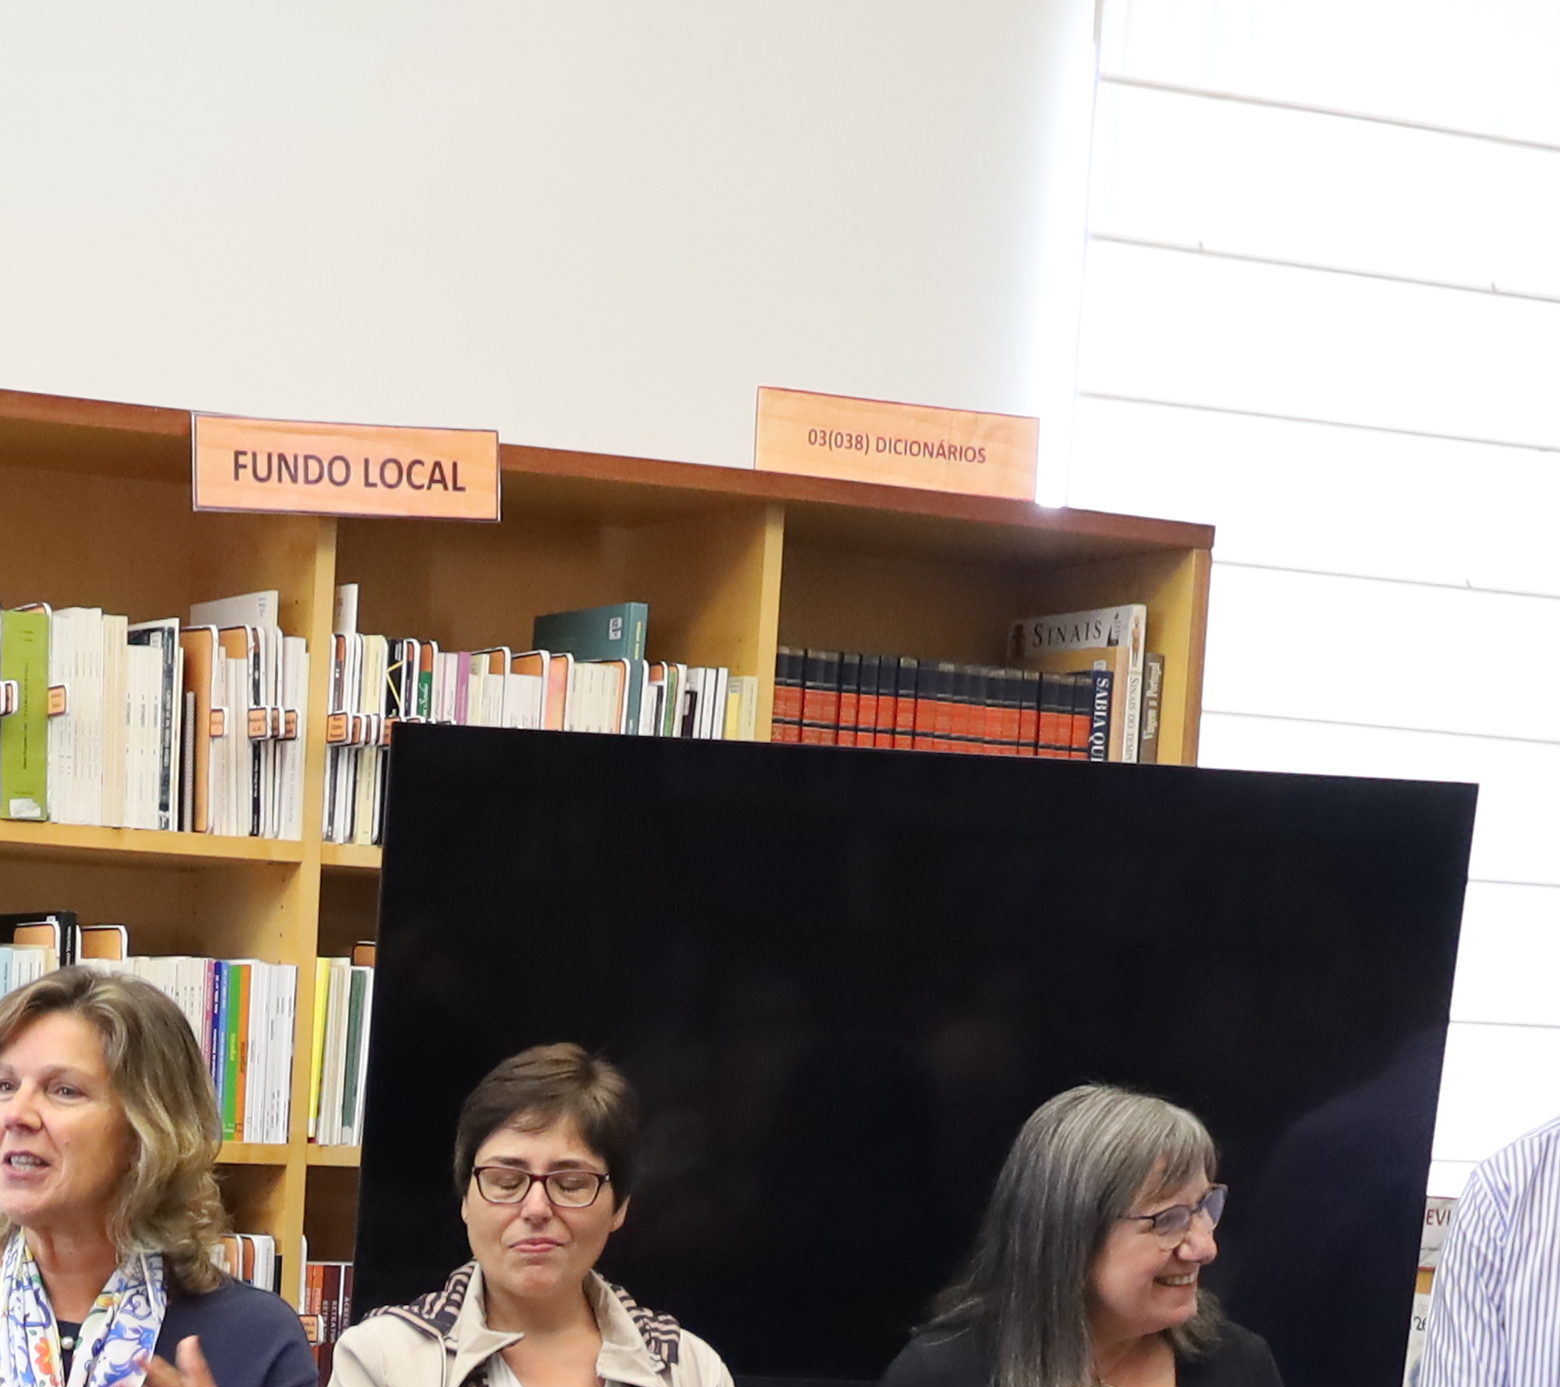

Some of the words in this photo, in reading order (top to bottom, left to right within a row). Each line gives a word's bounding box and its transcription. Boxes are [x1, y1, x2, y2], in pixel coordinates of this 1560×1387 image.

[806, 426, 870, 456] 03(038)
[874, 432, 988, 466] DICIONÁRIOS
[232, 450, 352, 488] FUNDO
[364, 456, 468, 492] LOCAL
[1032, 620, 1102, 648] SINAIS
[1128, 676, 1140, 711] SINAIS
[1146, 662, 1162, 698] Portugal
[1092, 677, 1110, 729] SABIA
[1128, 714, 1136, 729] DO
[1142, 708, 1158, 740] Viagem
